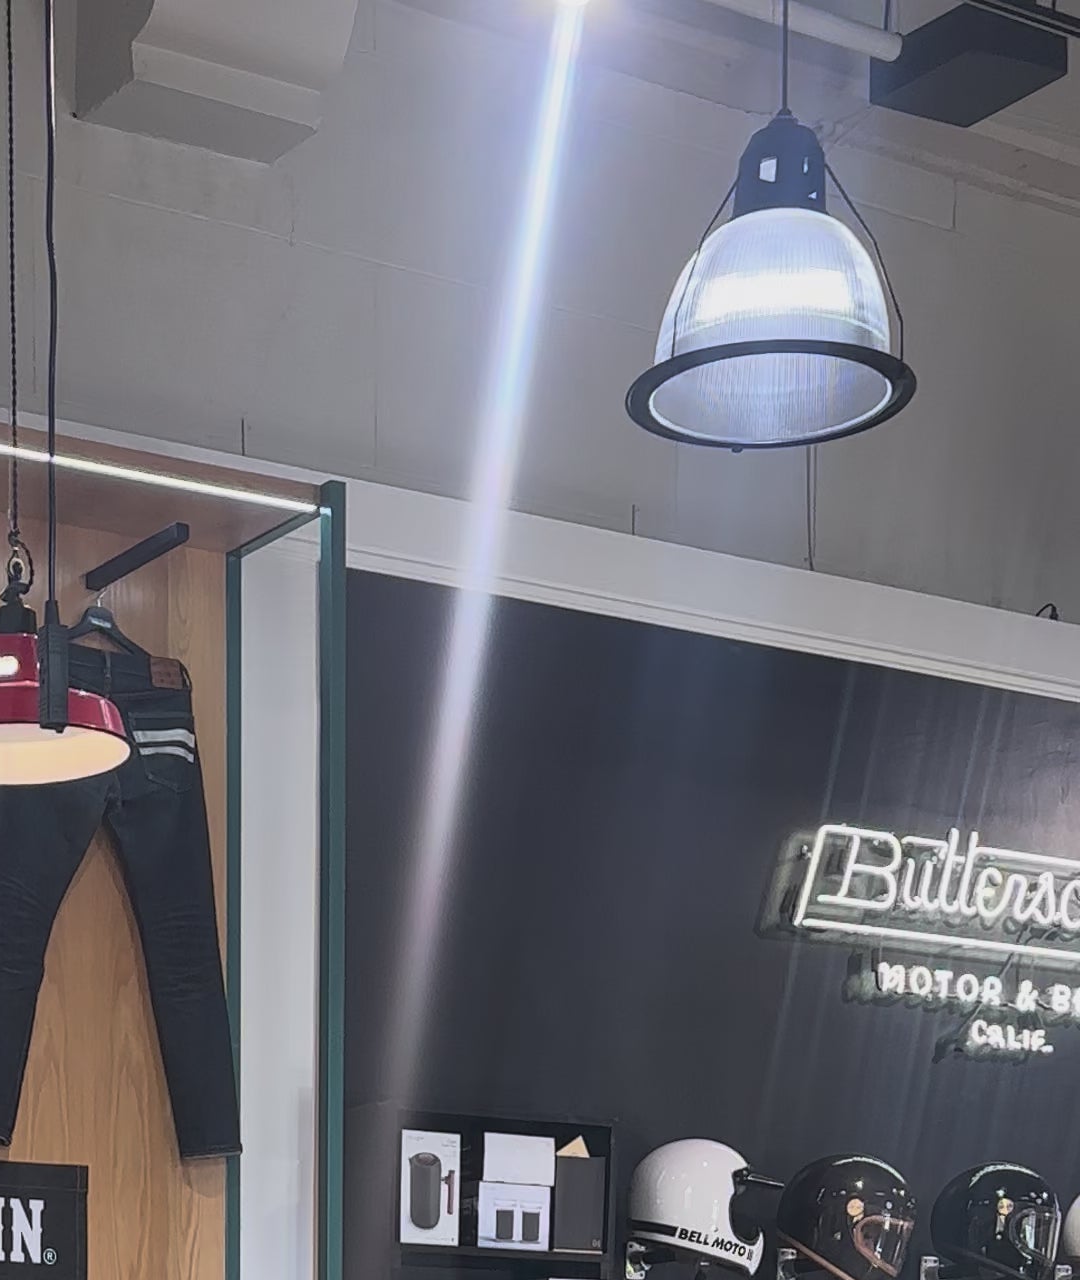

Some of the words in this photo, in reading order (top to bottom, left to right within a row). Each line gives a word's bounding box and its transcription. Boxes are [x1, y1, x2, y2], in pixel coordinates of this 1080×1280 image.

[876, 961, 1003, 1006] MOTOR
[1016, 979, 1039, 1013] &
[678, 1227, 710, 1247] BELL
[711, 1236, 748, 1258] MOTO
